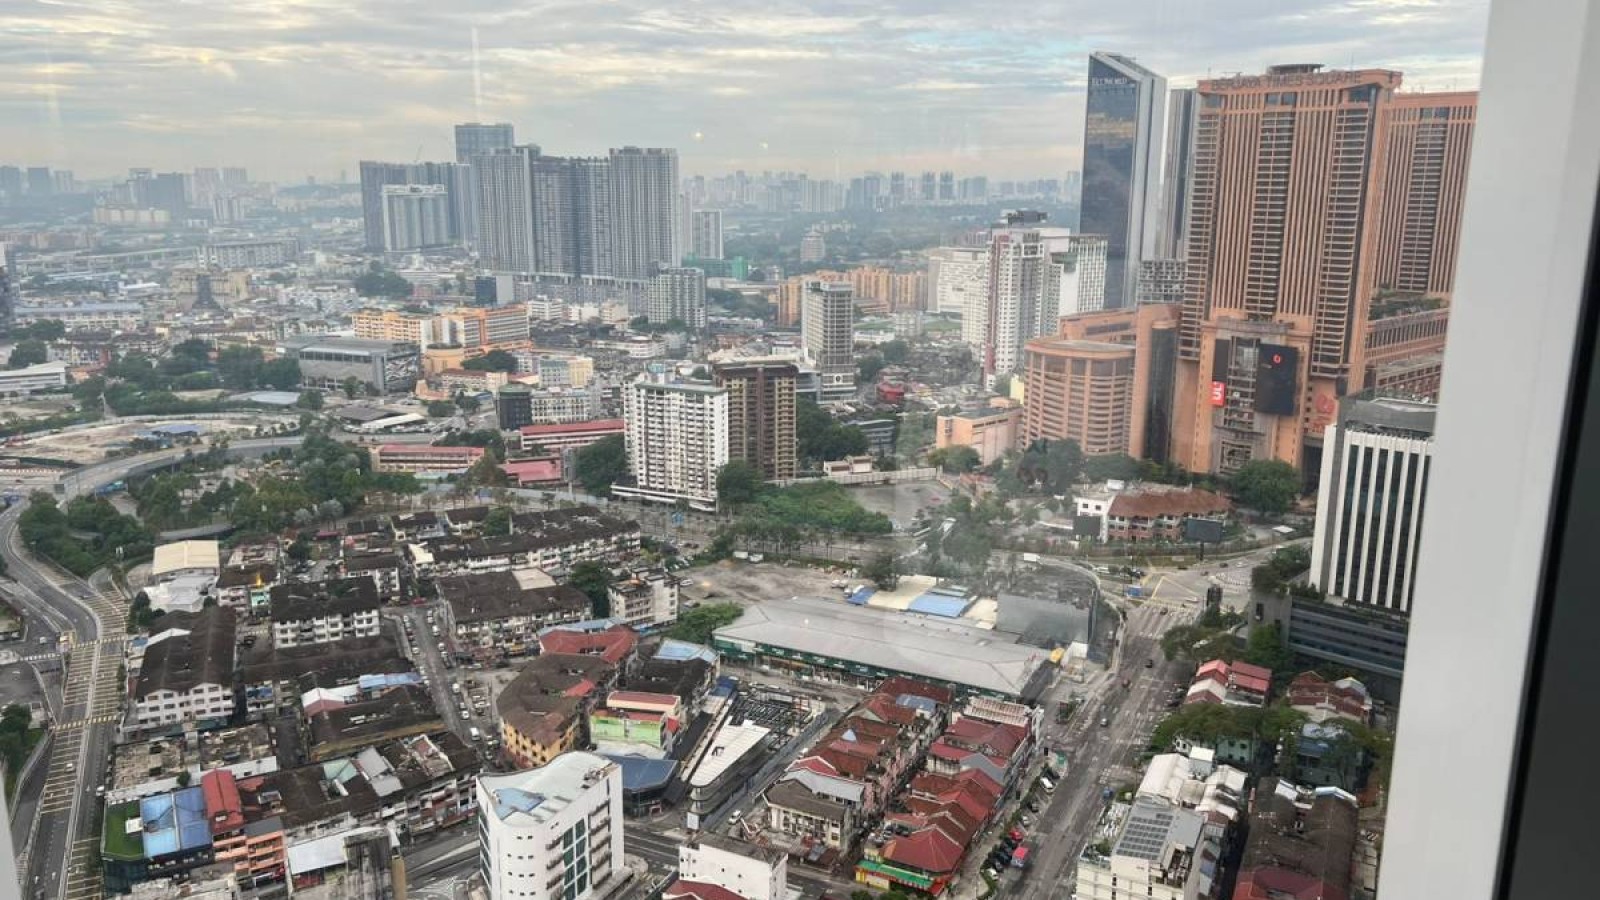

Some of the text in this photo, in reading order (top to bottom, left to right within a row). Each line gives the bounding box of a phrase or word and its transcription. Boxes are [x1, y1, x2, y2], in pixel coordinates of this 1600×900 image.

[1211, 69, 1361, 91] BERJAYA TIMES SQUARE
